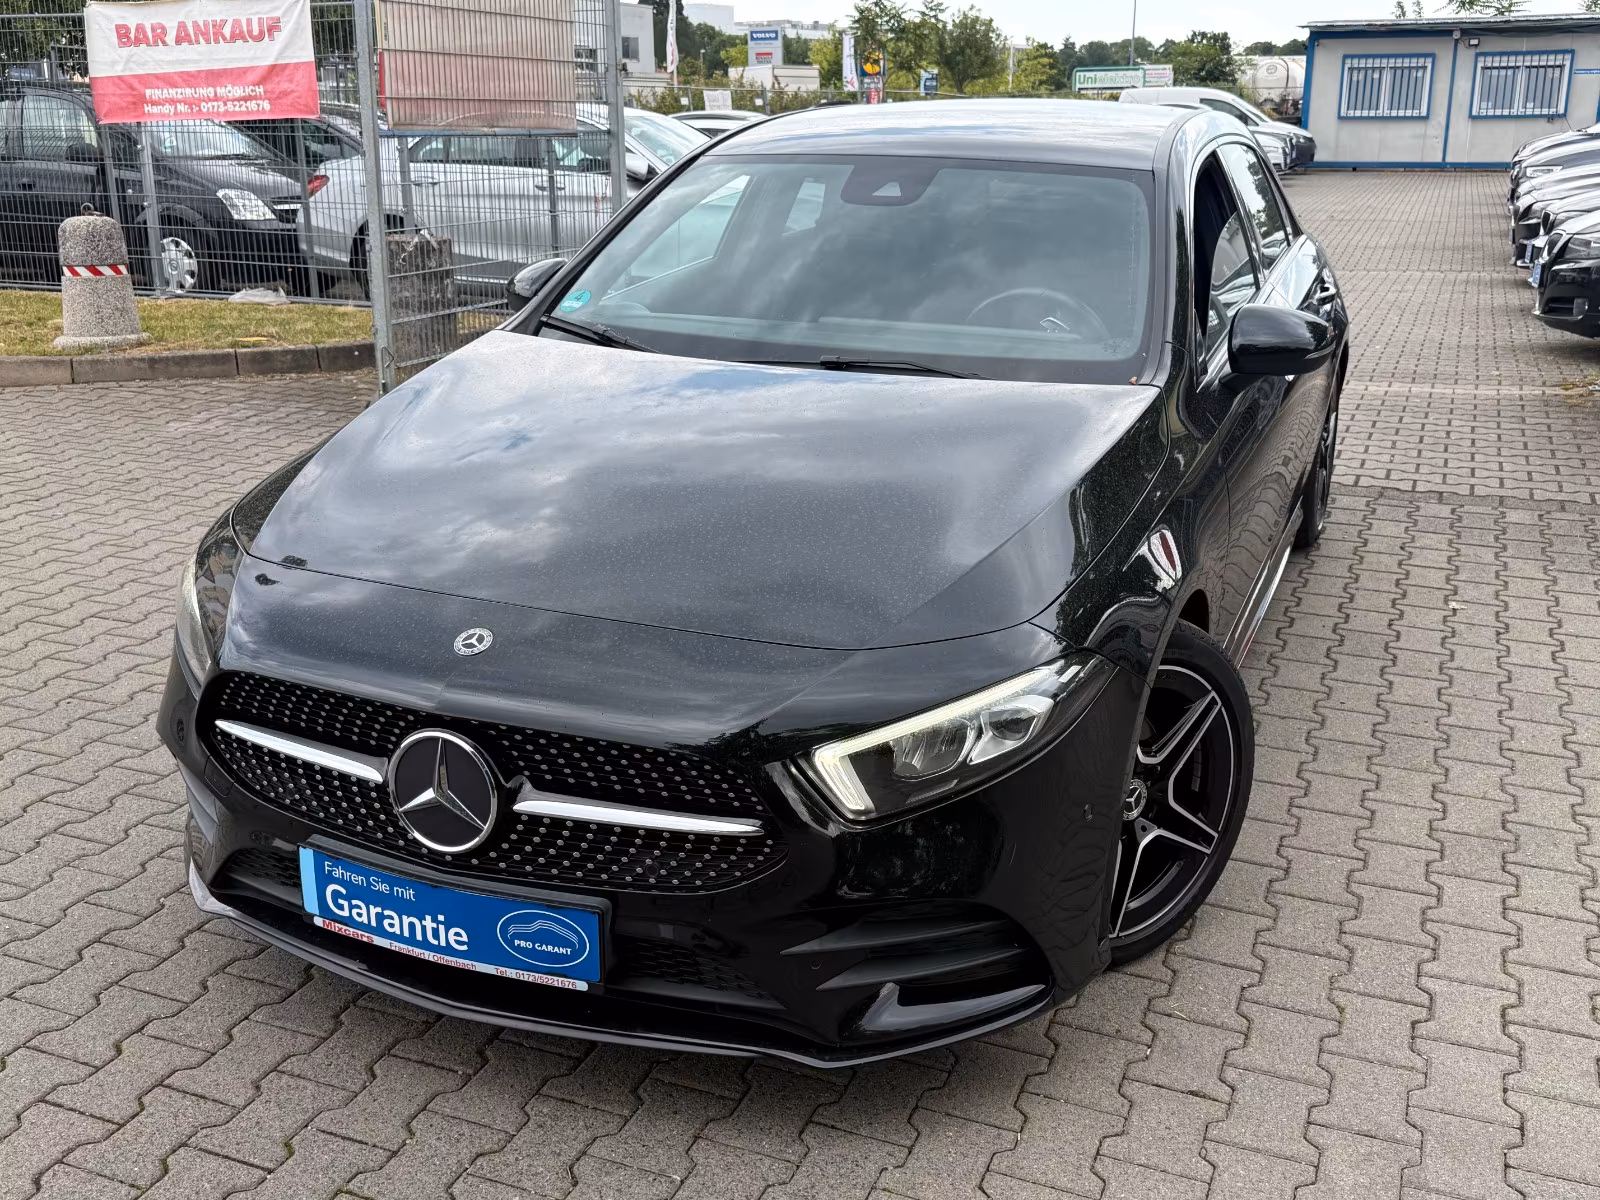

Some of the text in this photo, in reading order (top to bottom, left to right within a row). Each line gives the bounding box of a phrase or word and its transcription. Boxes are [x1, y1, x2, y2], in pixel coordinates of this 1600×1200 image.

[115, 16, 282, 48] BAR ANKAUF
[1078, 73, 1141, 85] Unielektro
[145, 84, 265, 99] FINANZIRUNG MÖGLICH
[144, 103, 175, 115] Handy
[176, 102, 191, 113] Nr.
[200, 100, 271, 112] 0173-5221676
[324, 861, 416, 901] Fahren Sie mit
[325, 883, 469, 951] Garantie
[322, 919, 375, 944] Mixcars
[389, 941, 426, 960] Frankfurt
[432, 954, 477, 971] Offenbach
[514, 939, 572, 956] PRO GARANT
[494, 967, 577, 989] Tel.: 0173/5221676
